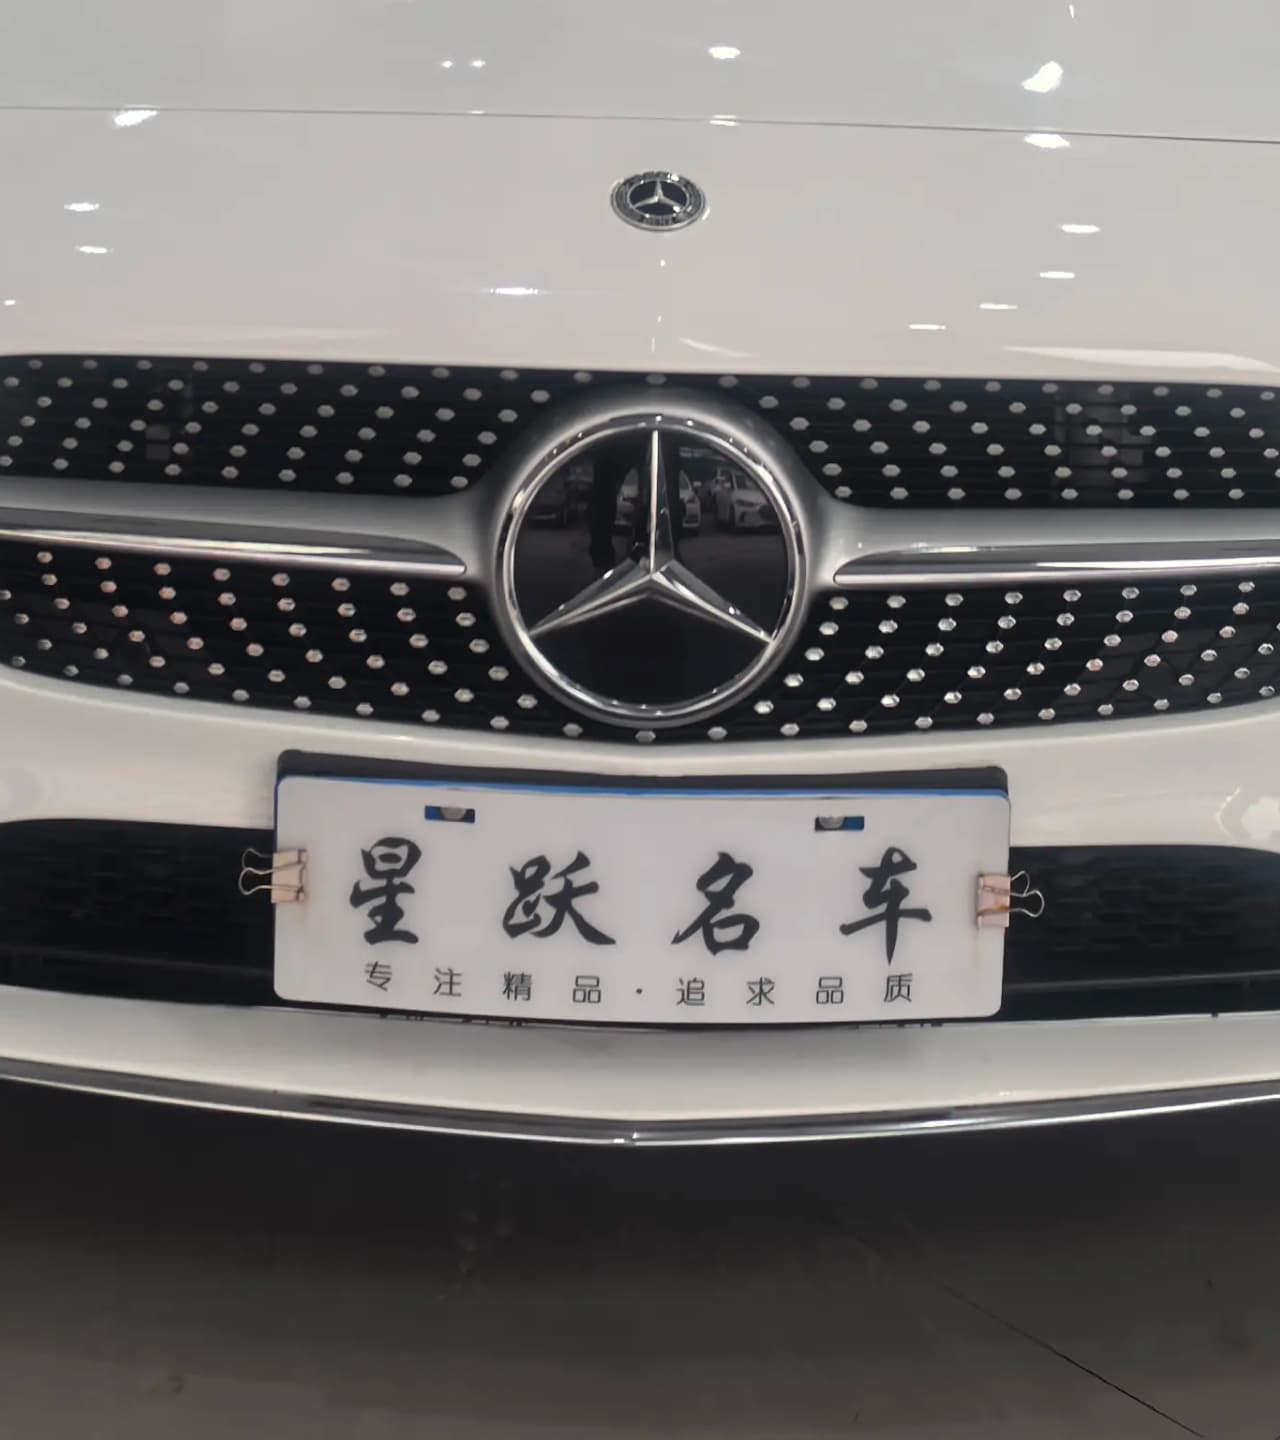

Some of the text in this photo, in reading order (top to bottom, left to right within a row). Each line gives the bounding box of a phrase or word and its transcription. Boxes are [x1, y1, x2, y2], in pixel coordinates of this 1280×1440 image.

[350, 836, 933, 965] 星跃名车
[364, 961, 914, 1006] 专注精品·追求品质
